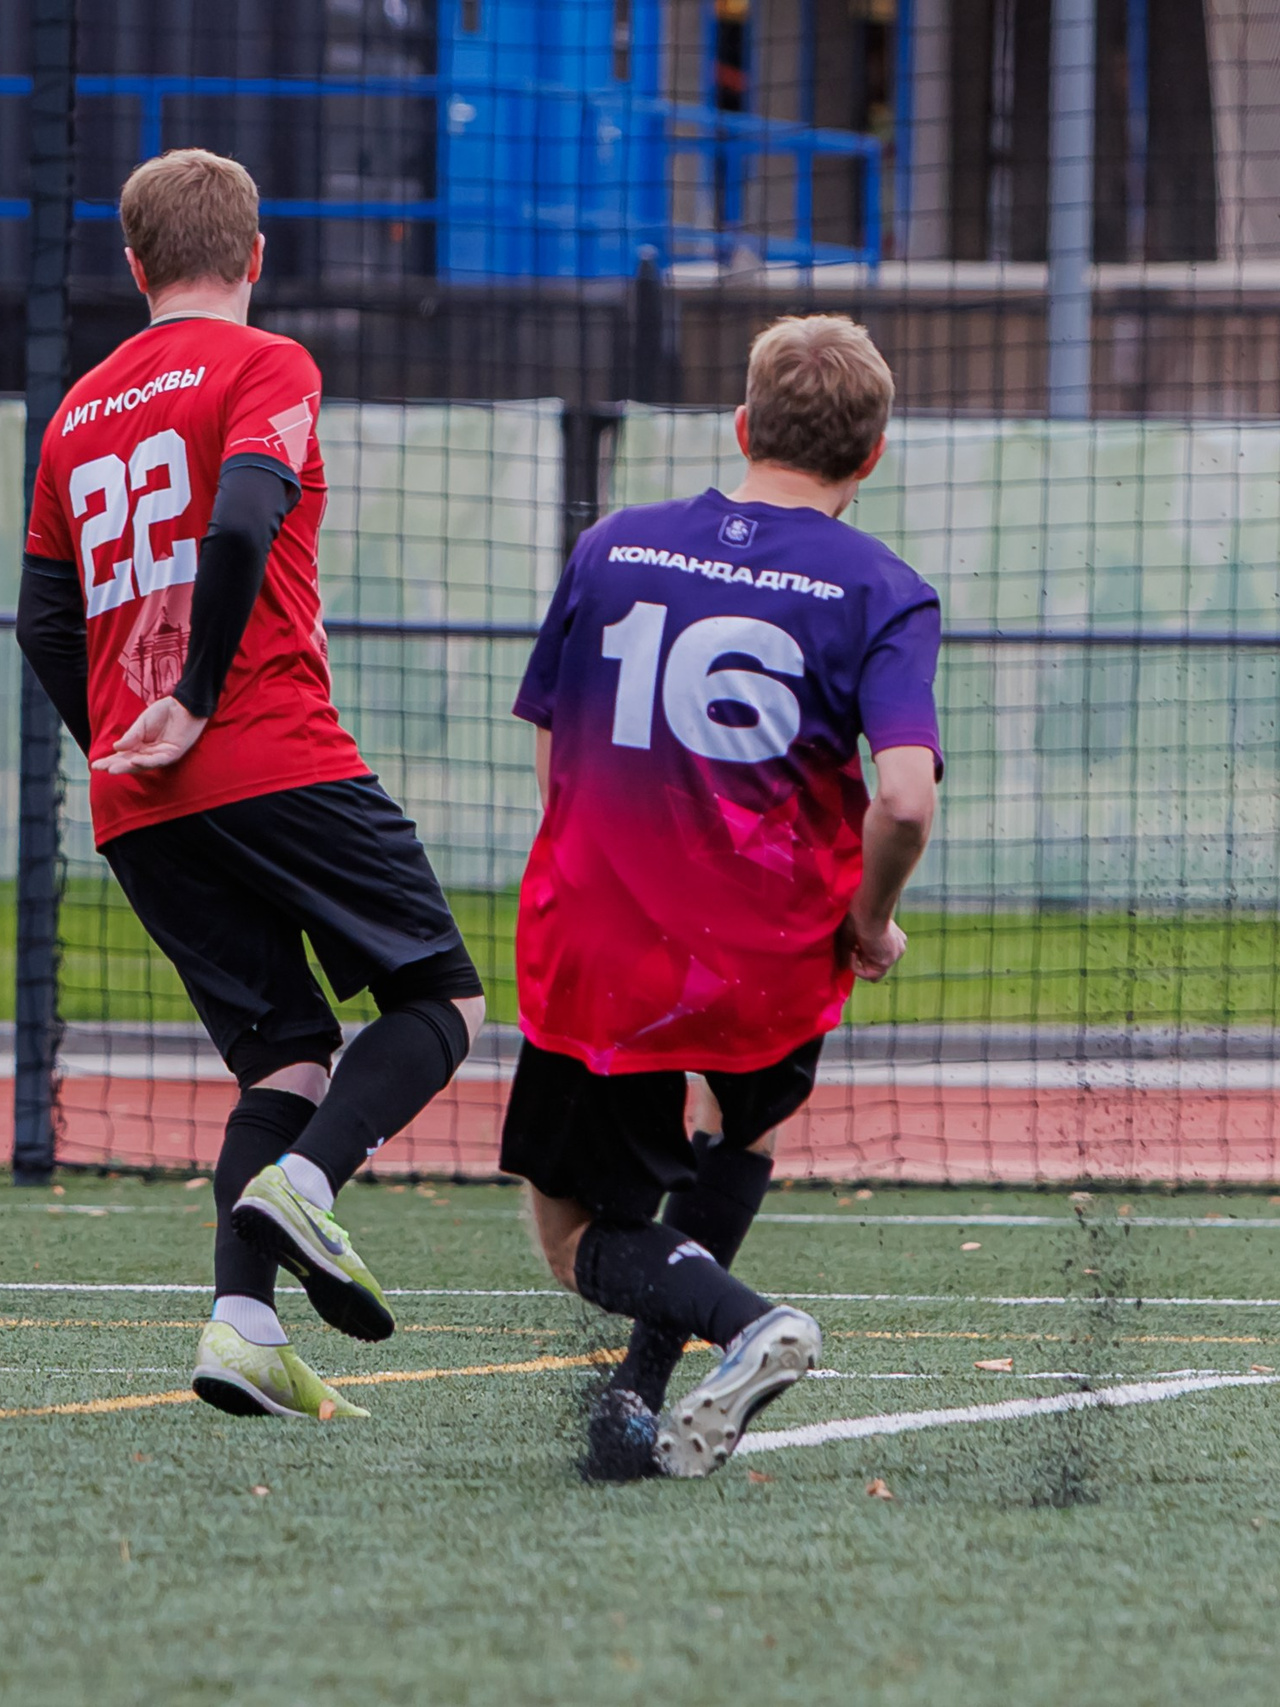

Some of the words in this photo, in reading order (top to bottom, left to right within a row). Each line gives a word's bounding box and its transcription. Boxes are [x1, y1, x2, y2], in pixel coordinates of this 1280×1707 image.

[61, 399, 102, 437] ДИТ
[104, 366, 206, 416] МОСКВЫ
[69, 428, 198, 619] 22
[608, 546, 754, 585] КОМАНДА
[755, 570, 845, 600] ДПИР
[601, 601, 805, 763] 16
